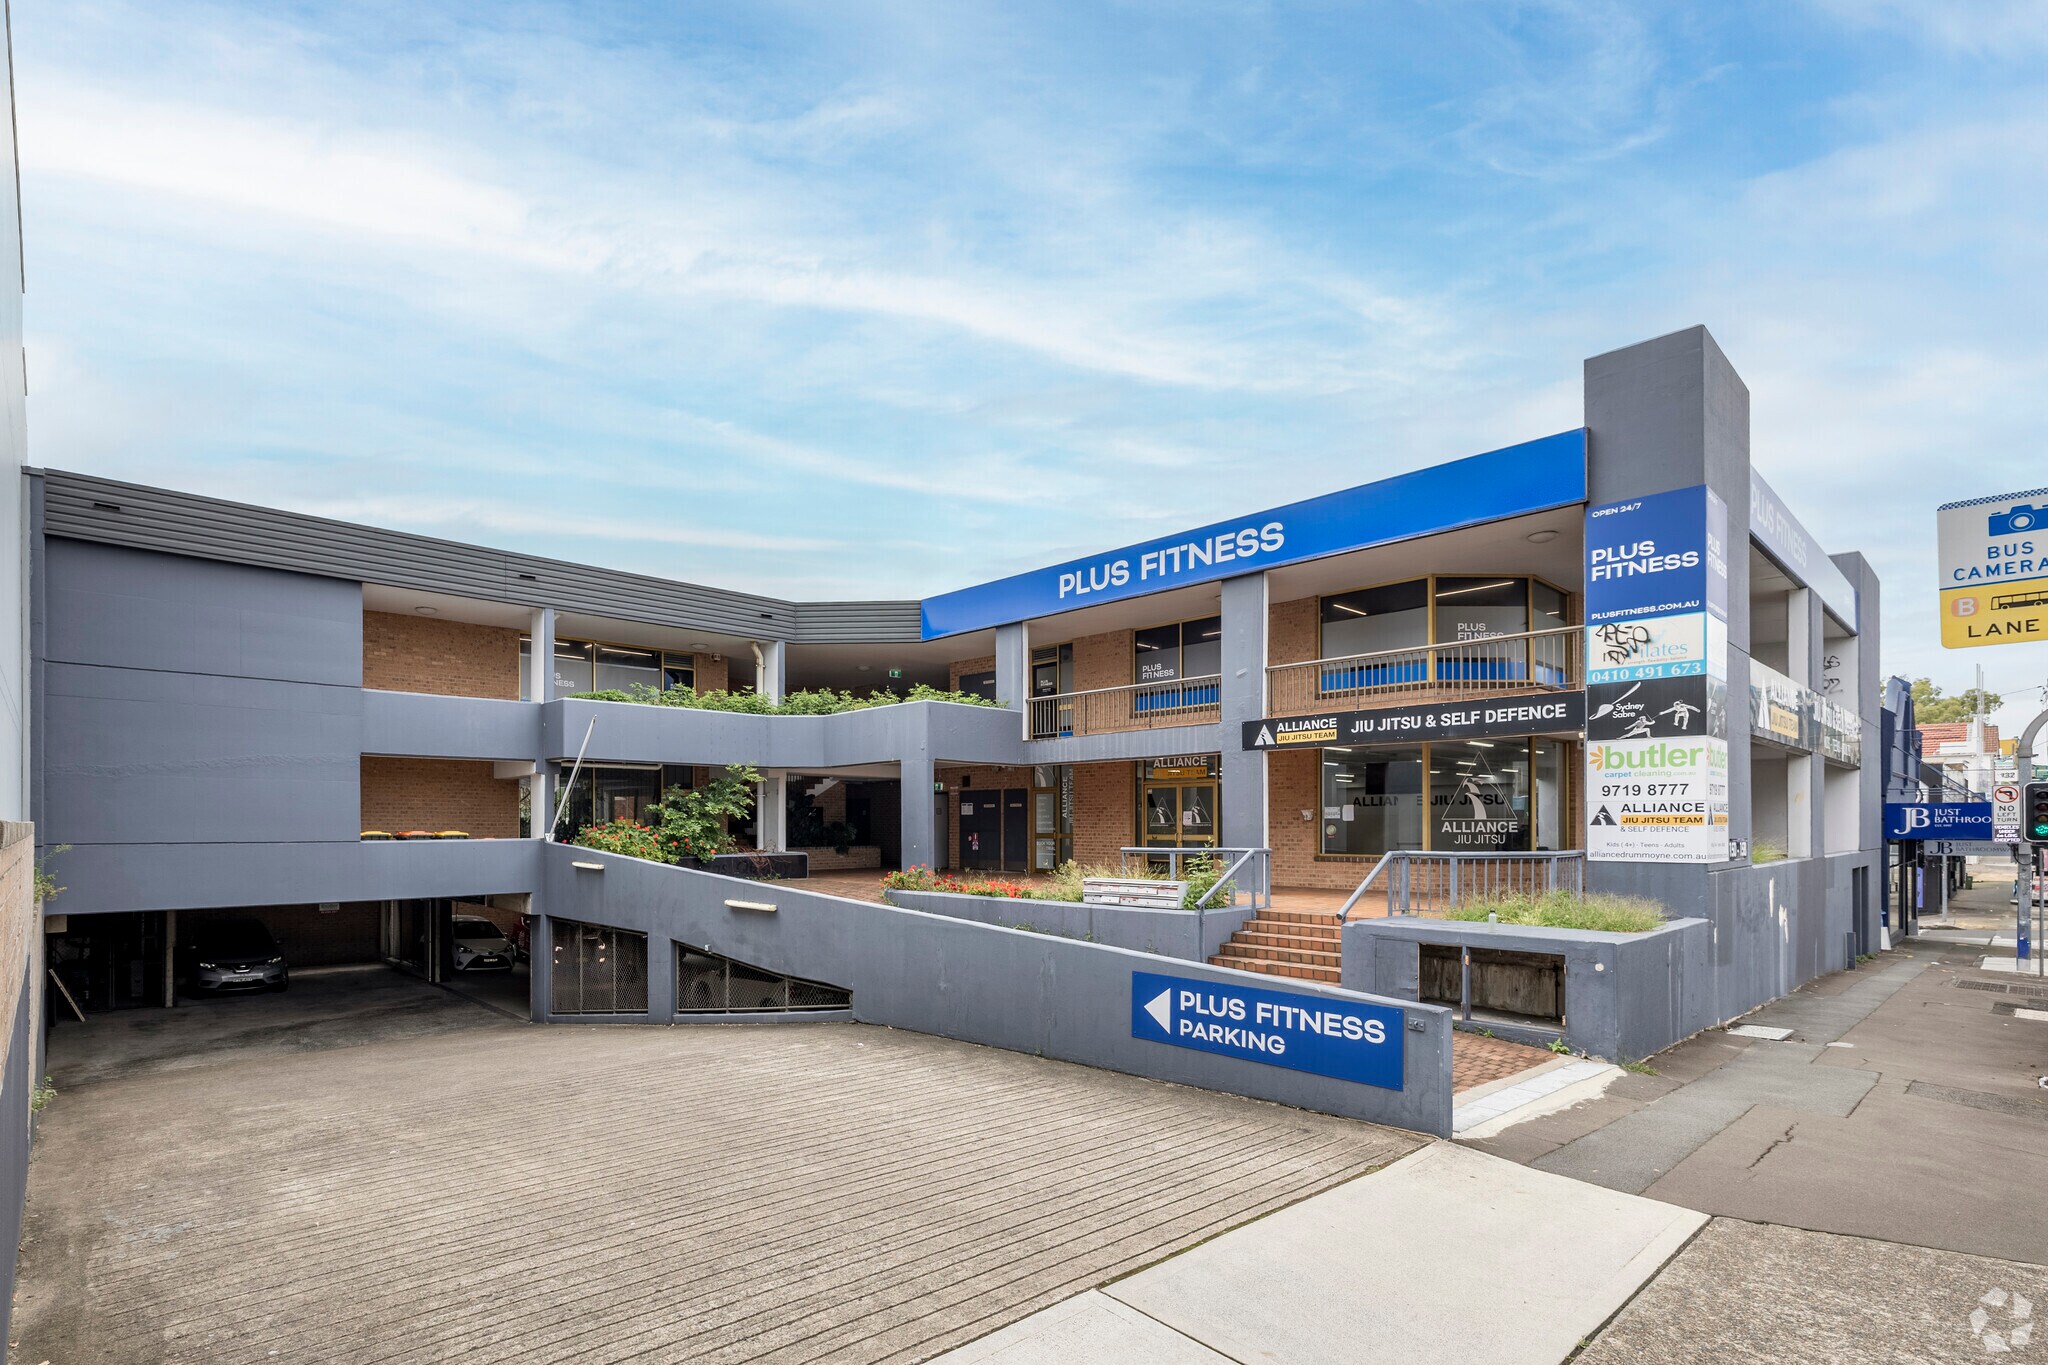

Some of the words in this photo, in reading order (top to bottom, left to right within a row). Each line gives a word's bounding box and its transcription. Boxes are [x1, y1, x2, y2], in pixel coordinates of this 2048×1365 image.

[1592, 506, 1618, 518] OPEN
[1620, 502, 1642, 513] 24/7
[1751, 483, 1774, 534] PLUS
[1776, 512, 1806, 568] FITNESS
[1591, 540, 1655, 565] PLUS
[1988, 541, 2033, 559] BUS
[1059, 560, 1129, 599] PLUS
[1141, 522, 1285, 581] FITNESS
[1591, 551, 1699, 582] FITNESS
[1954, 557, 2048, 581] CAMERA
[1592, 600, 1699, 620] PLUSFITNESS.COM.AU
[1958, 598, 1975, 616] B
[1457, 623, 1486, 631] PLUS
[1968, 619, 2039, 638] LANE
[1142, 663, 1161, 672] PLUS
[1592, 669, 1629, 682] 0410
[1635, 666, 1662, 679] 491
[1671, 662, 1701, 675] 673
[1612, 711, 1636, 719] Sabre
[1615, 702, 1645, 711] Sydney
[1277, 718, 1337, 732] ALLIANCE
[1351, 719, 1374, 733] JIU
[1378, 715, 1421, 731] JITSU
[1426, 715, 1436, 727] &
[1440, 711, 1480, 726] SELF
[1485, 703, 1567, 723] DEFENCE
[1153, 757, 1208, 768] ALLIANCE
[1604, 743, 1704, 770] butler
[1604, 771, 1632, 779] carpet
[1601, 784, 1641, 797] 9719
[1647, 783, 1689, 796] 8777
[1621, 803, 1705, 813] ALLIANCE
[1441, 822, 1518, 833] ALLIANCE
[1894, 808, 1930, 834] JB
[1935, 809, 1961, 817] JUST
[1454, 835, 1471, 844] JIU
[1474, 834, 1506, 844] JITSU
[1930, 842, 1952, 854] JB
[1590, 850, 1707, 861] alliancedrummoyne.com.au
[1180, 990, 1246, 1021] PLUS
[1256, 1002, 1386, 1044] FITNESS
[1180, 1019, 1286, 1055] PARKING
